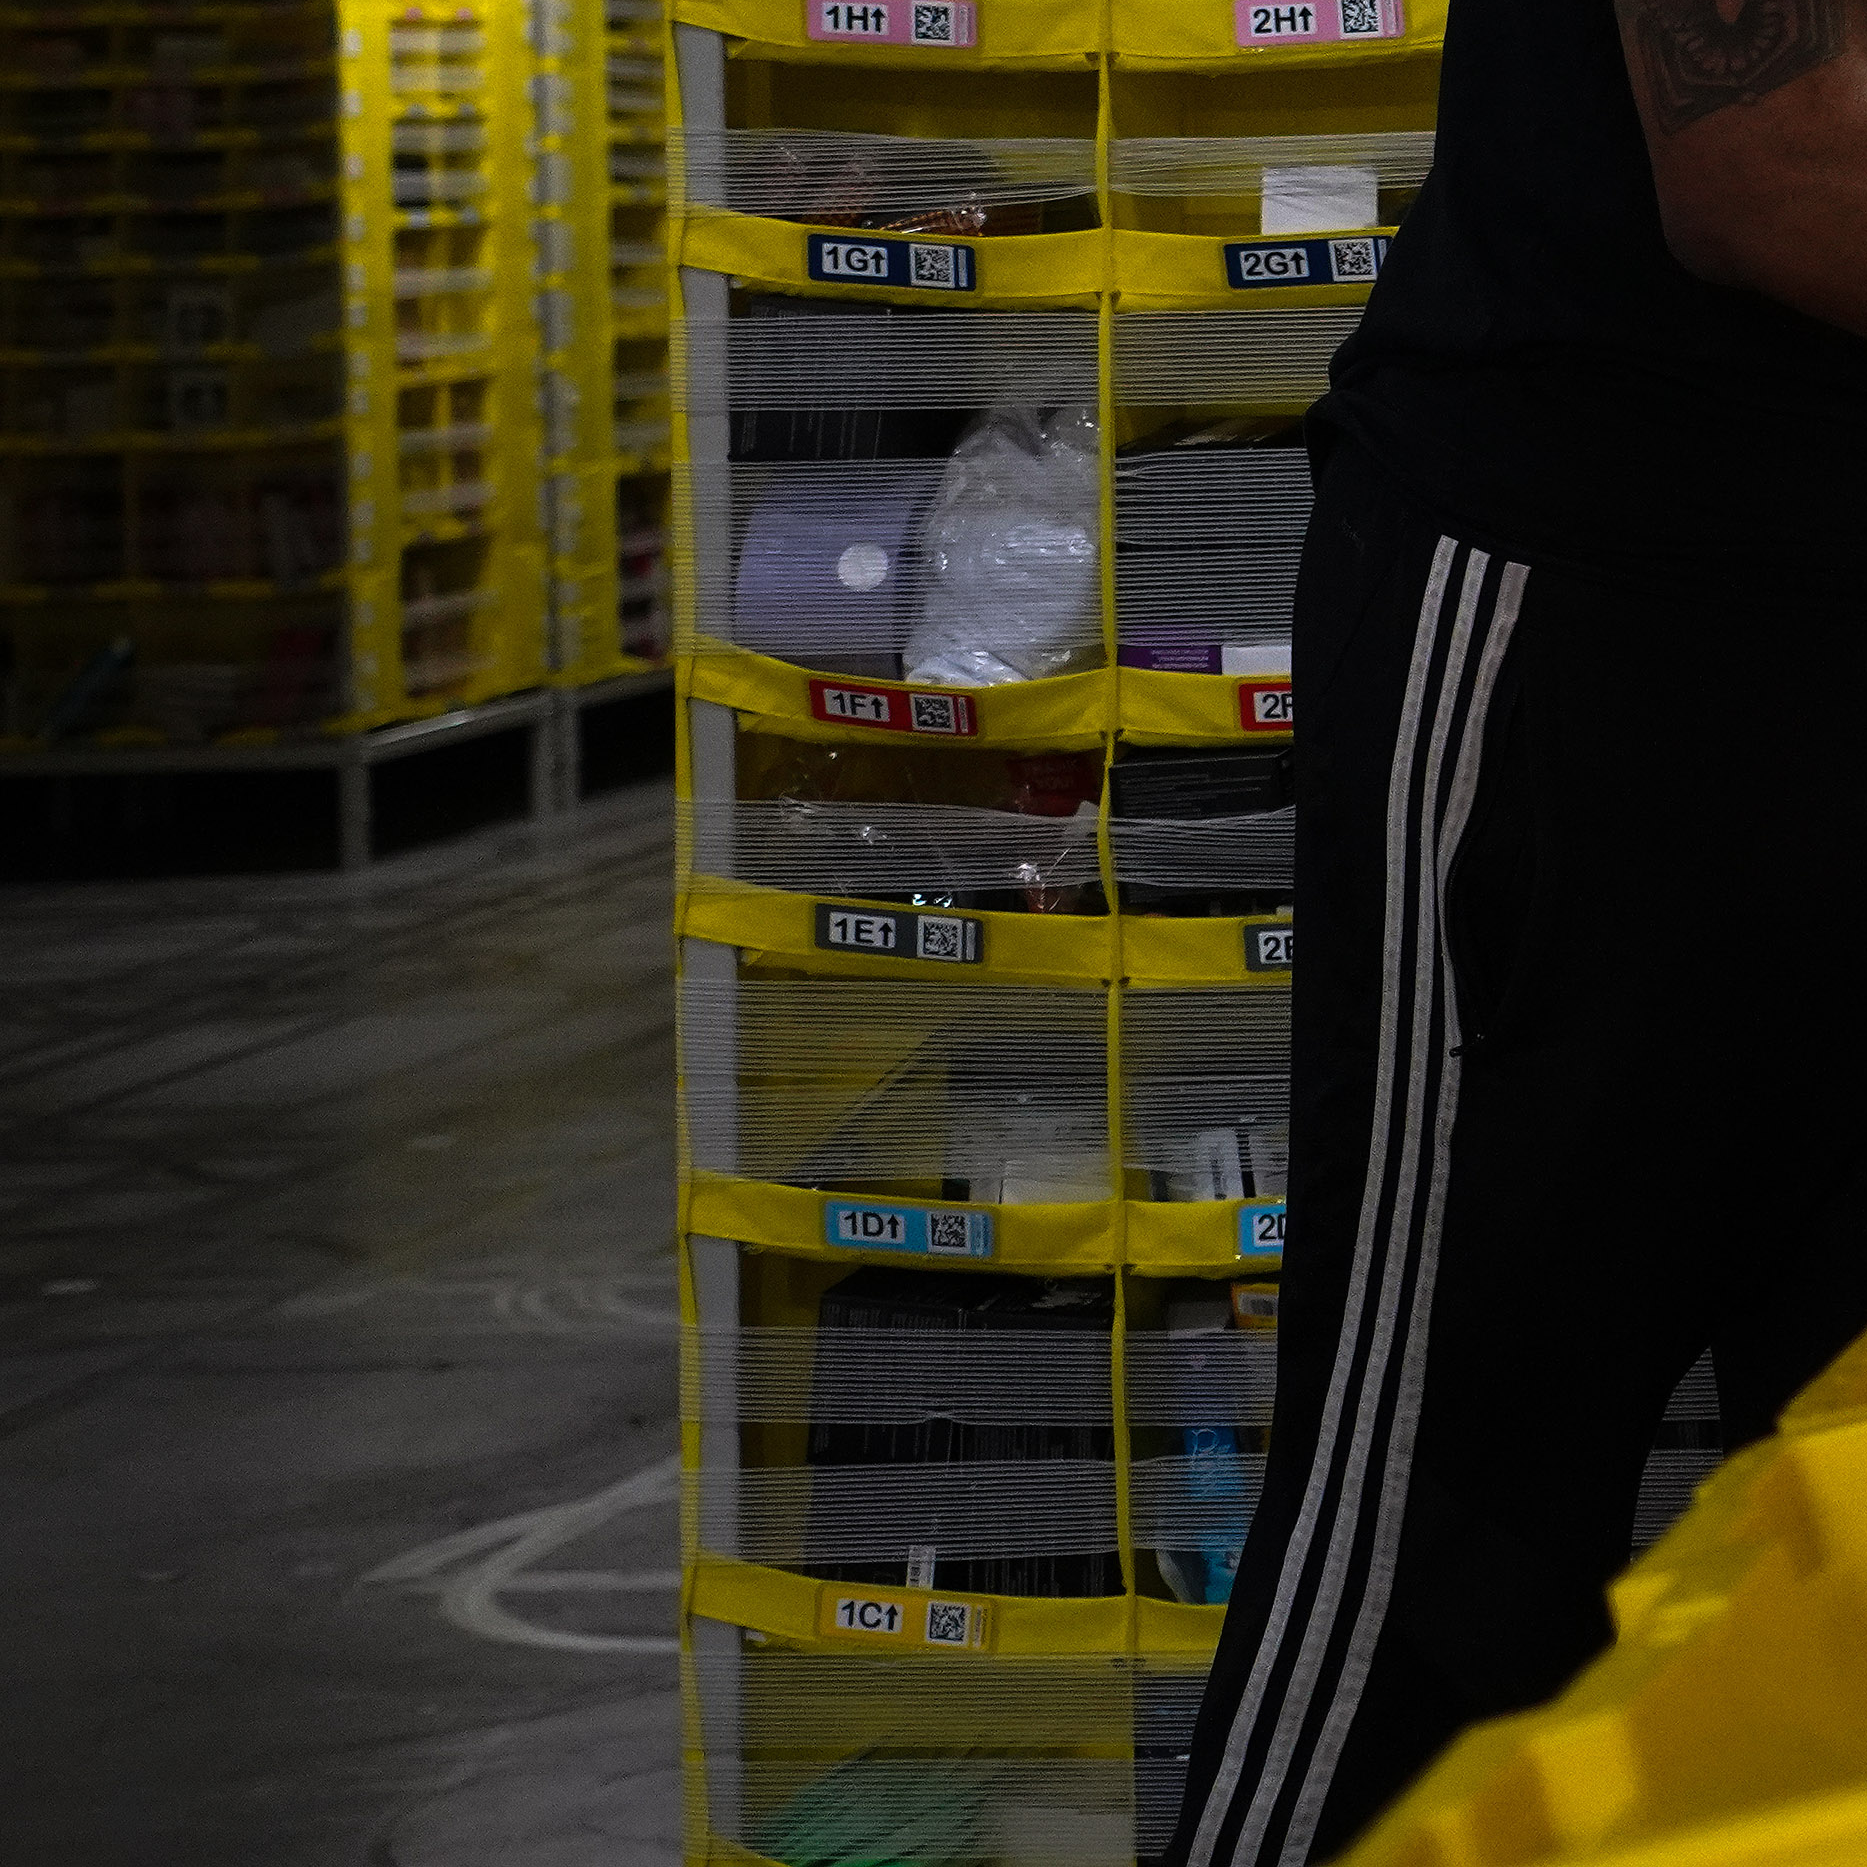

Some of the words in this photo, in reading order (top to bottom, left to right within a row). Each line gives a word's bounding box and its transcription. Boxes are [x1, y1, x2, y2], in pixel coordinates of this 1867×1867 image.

[826, 6, 868, 31] 1H
[1254, 7, 1296, 33] 2H
[826, 246, 868, 272] 1G
[1244, 252, 1288, 276] 2G
[833, 692, 869, 717] 1F
[834, 918, 874, 944] 1E
[844, 1212, 884, 1238] 1D
[842, 1601, 882, 1628] 1C
